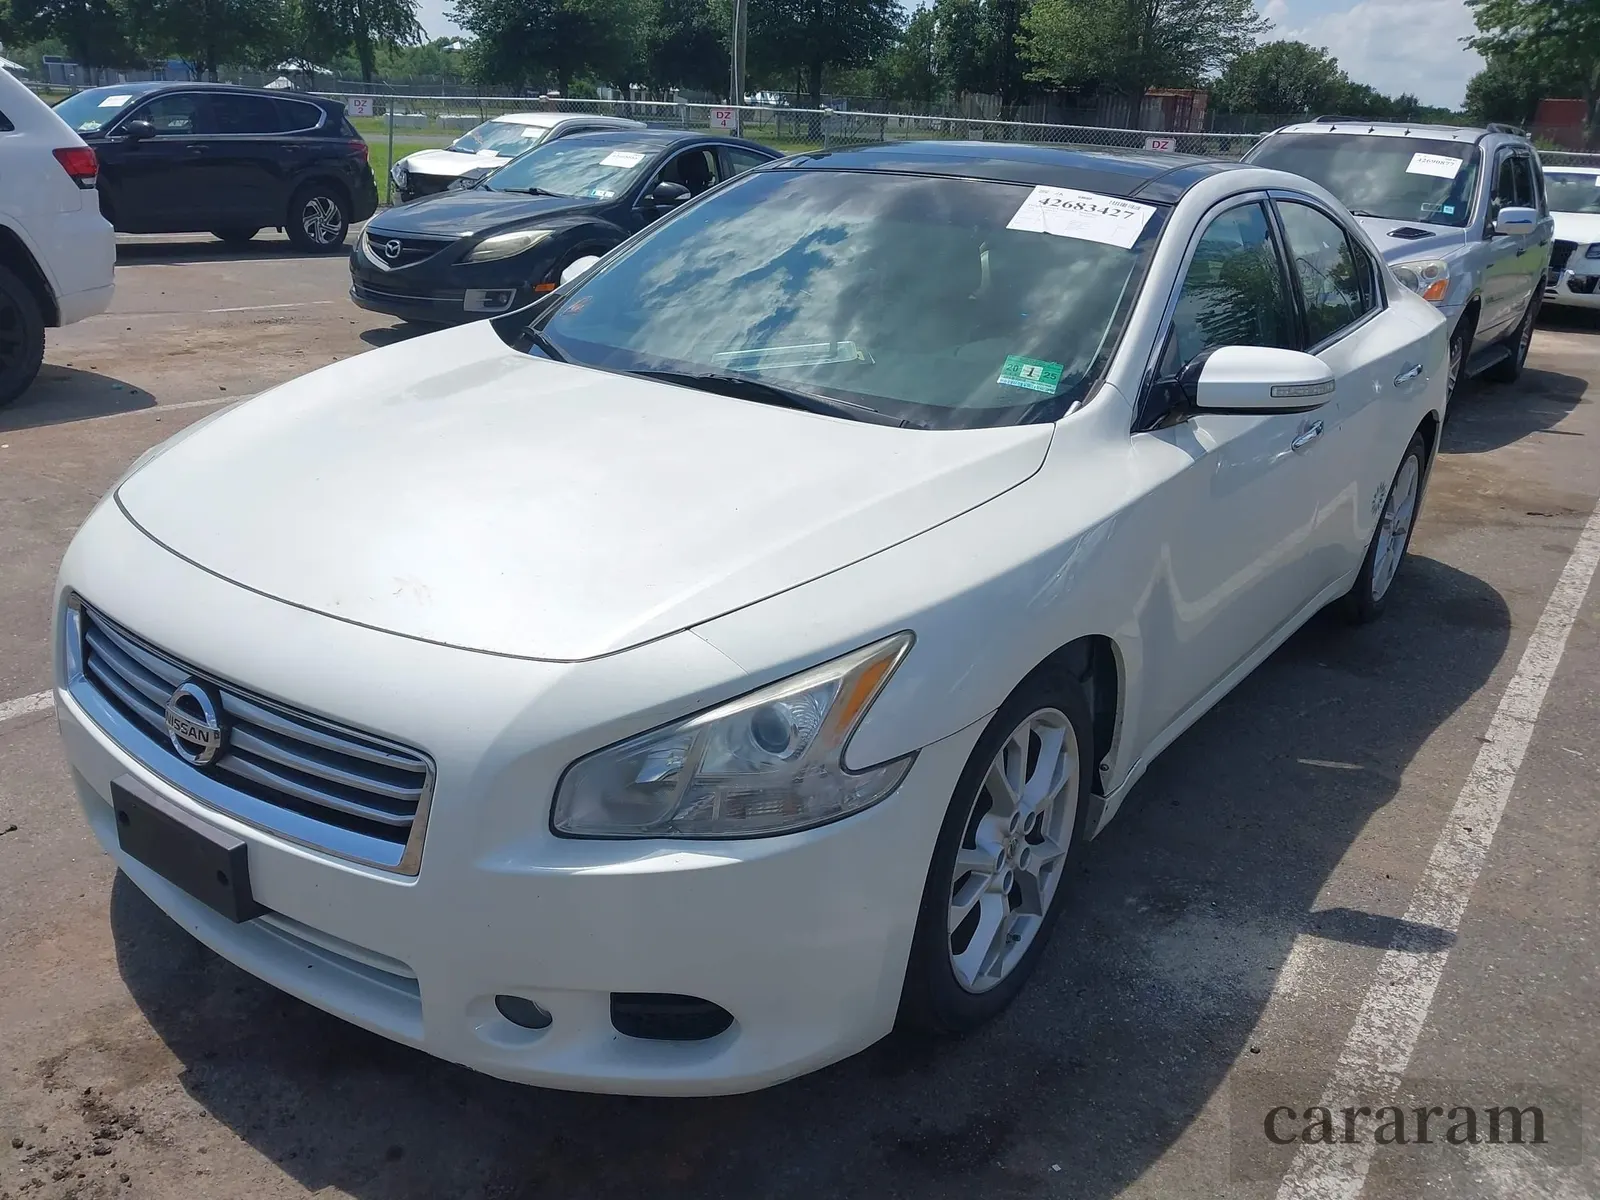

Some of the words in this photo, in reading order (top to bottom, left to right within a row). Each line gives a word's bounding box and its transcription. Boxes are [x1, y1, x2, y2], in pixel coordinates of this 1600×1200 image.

[354, 99, 367, 107] DZ
[716, 111, 731, 119] DZ
[1152, 141, 1169, 149] DZ
[1038, 197, 1134, 220] 42683427
[1006, 363, 1019, 372] 20
[1027, 367, 1035, 377] 1
[1043, 371, 1057, 380] 25
[165, 710, 209, 743] NISSAN
